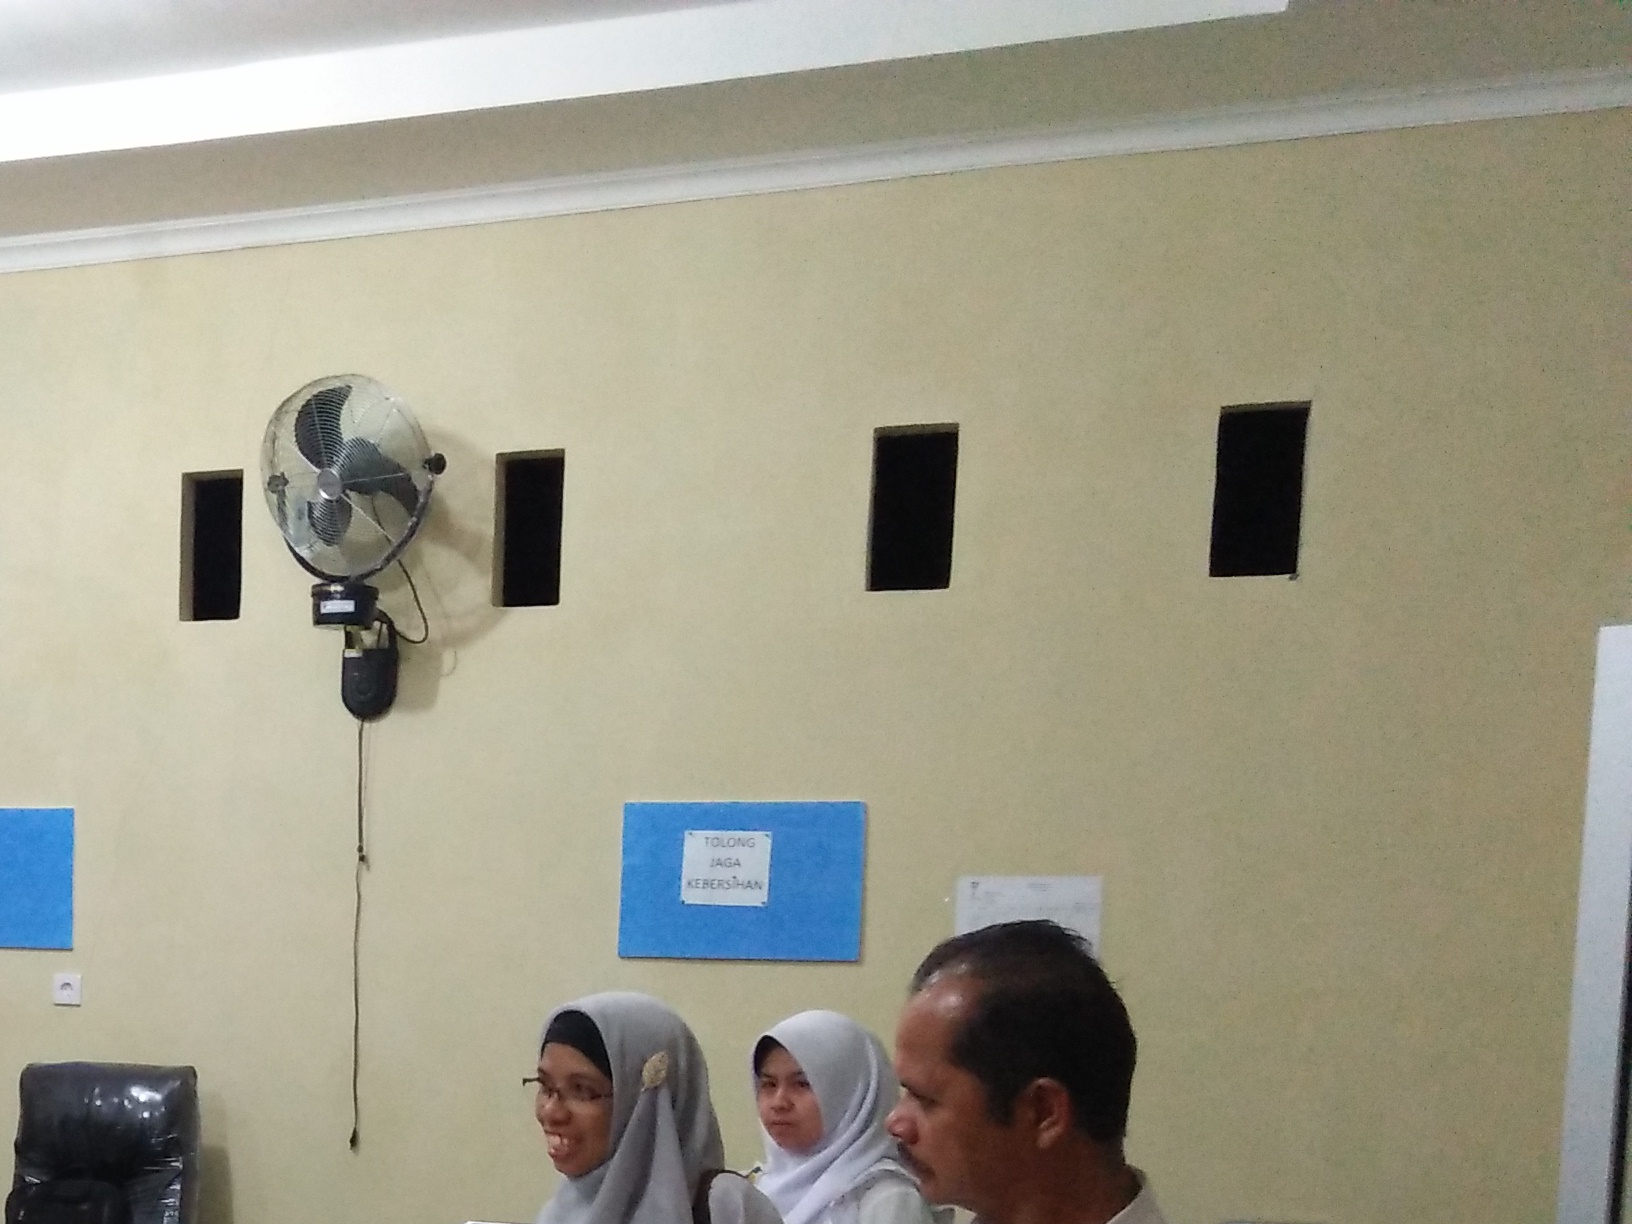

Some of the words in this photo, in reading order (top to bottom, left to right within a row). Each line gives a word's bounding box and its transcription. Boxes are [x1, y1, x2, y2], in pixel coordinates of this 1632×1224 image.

[704, 836, 756, 848] TOLONG
[709, 857, 742, 868] JAGA
[687, 878, 763, 890] KEBERSIHAN
